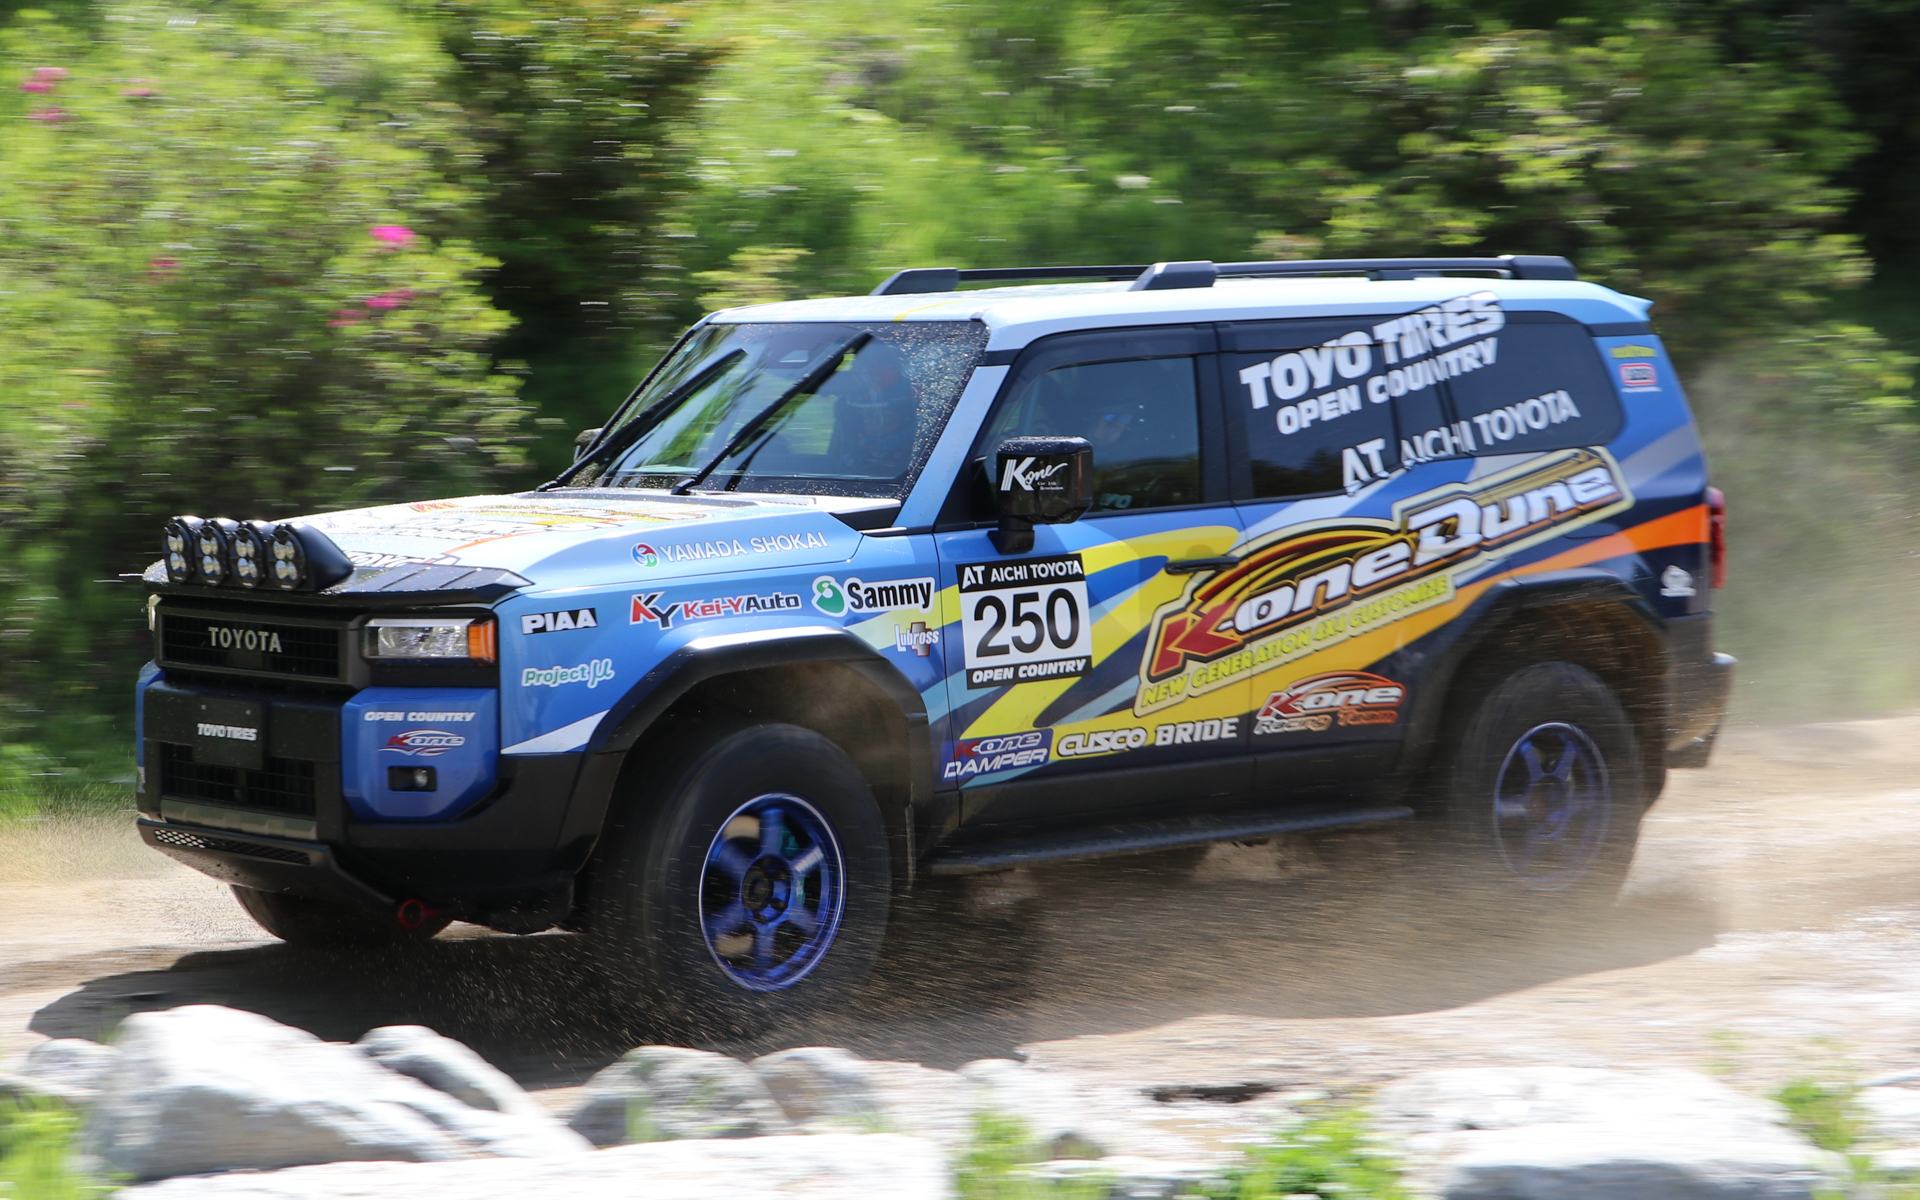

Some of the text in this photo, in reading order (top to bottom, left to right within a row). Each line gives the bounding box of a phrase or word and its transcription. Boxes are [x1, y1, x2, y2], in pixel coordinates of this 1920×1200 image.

[1239, 290, 1505, 409] TOYO TIRES
[1276, 337, 1498, 435] OPEN COUNTRY
[1342, 390, 1581, 496] AT AICHI TOYOTA
[659, 531, 828, 563] YAMADA SHOKAI
[962, 560, 1083, 589] AT AICHI TOYOTA
[630, 591, 681, 629] KY
[848, 581, 932, 610] Sammy
[521, 608, 598, 634] PIAA
[974, 588, 1079, 658] 250
[208, 626, 282, 653] TOYOTA
[895, 624, 939, 652] Lubross
[1141, 672, 1190, 708] NEW
[1192, 626, 1312, 689] GENERATION
[1350, 574, 1448, 628] CUSTOMIZE
[523, 666, 588, 685] Project
[972, 659, 1086, 684] OPEN COUNTRY
[364, 711, 476, 722] OPEN COUNTRY
[197, 723, 258, 741] TOYO TIRES
[1057, 717, 1239, 757] CUSCO BRIDE
[944, 748, 1047, 779] DAMPER
